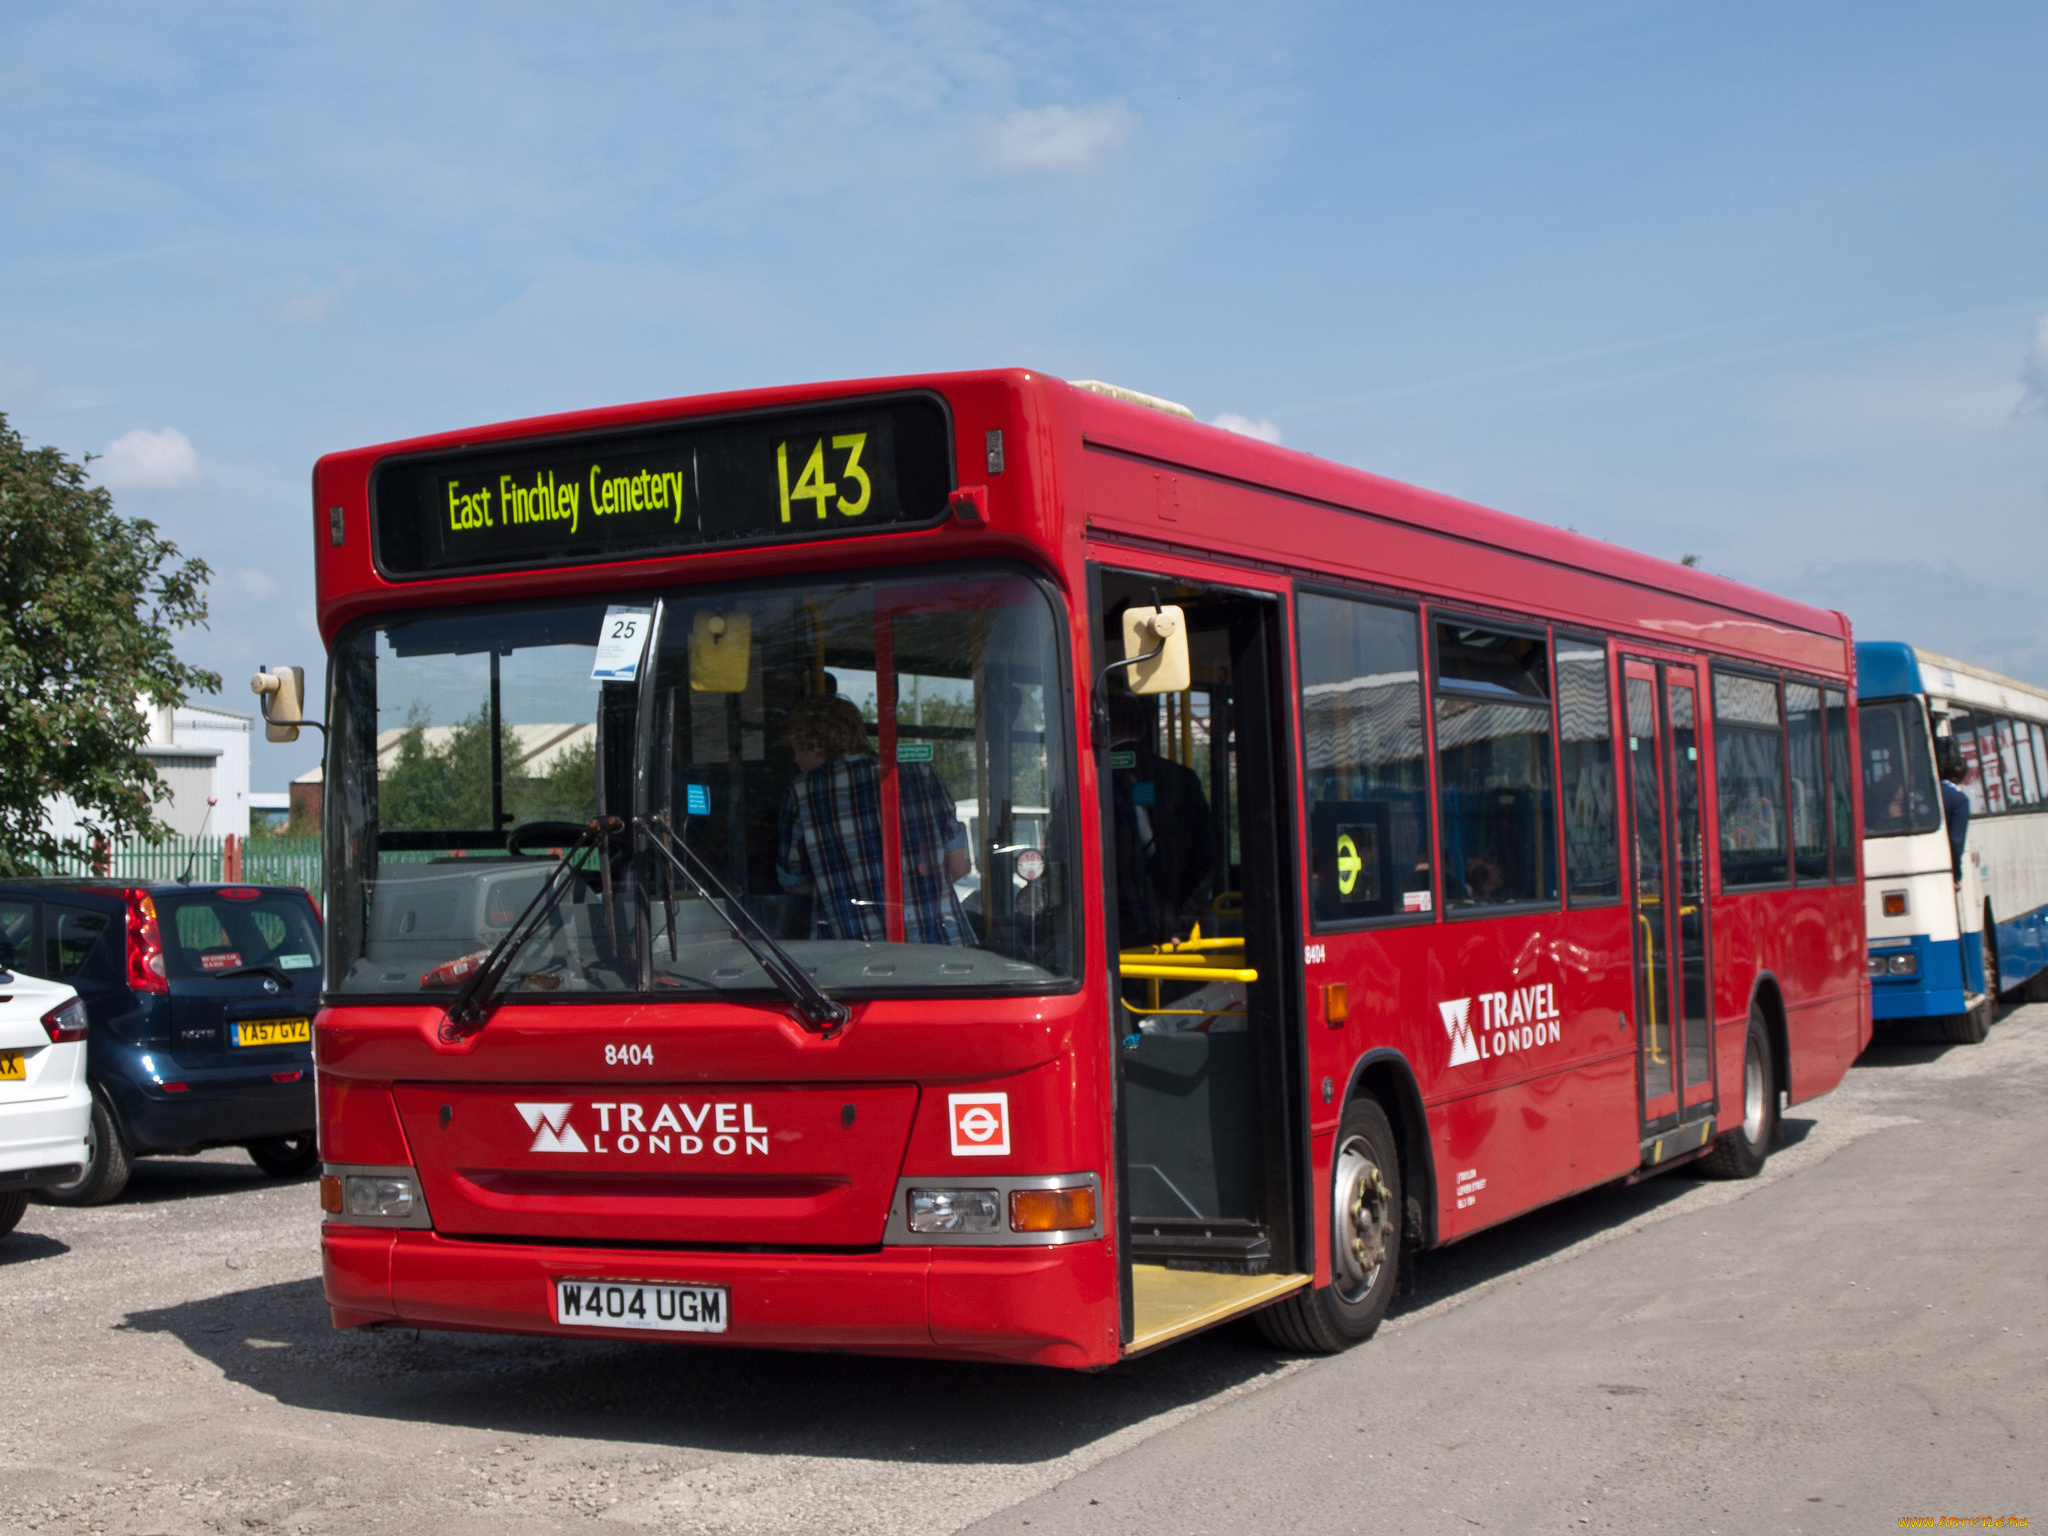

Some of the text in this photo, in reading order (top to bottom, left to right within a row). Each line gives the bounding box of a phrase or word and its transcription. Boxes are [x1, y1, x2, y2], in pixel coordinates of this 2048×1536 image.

[777, 433, 871, 523] 143
[448, 465, 683, 534] East Finchley Cemetery
[611, 620, 637, 639] 25
[1303, 944, 1326, 965] 8404
[1478, 982, 1561, 1032] TRAVEL
[240, 1020, 307, 1041] YA57 GVZ
[1480, 1020, 1561, 1059] LONDON
[604, 1044, 654, 1066] 8404
[591, 1102, 768, 1133] TRAVEL
[593, 1134, 769, 1156] LONDON
[563, 1284, 721, 1324] W404 UGM
